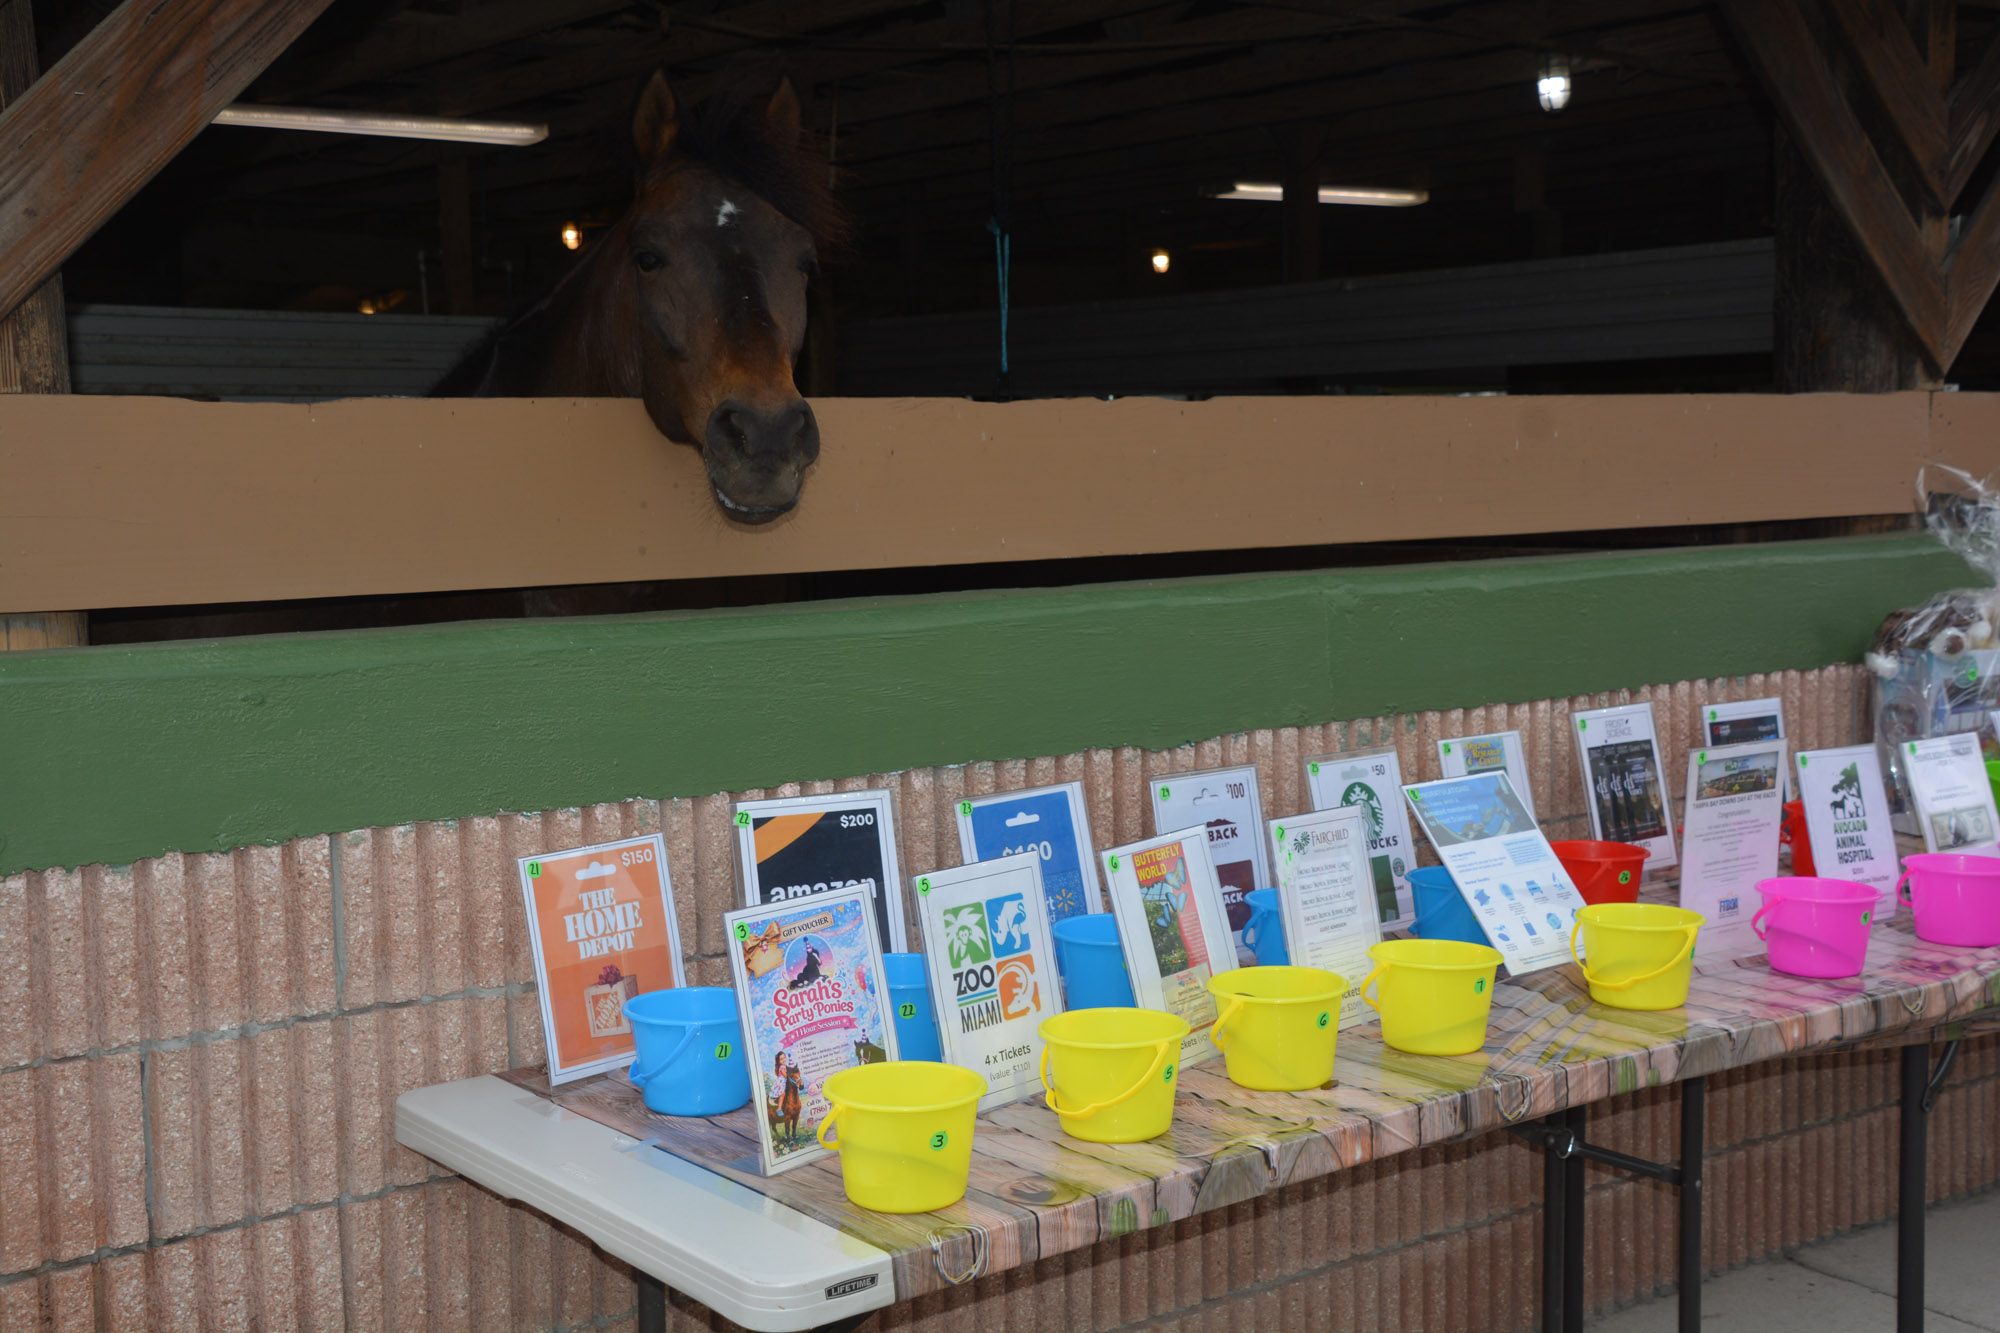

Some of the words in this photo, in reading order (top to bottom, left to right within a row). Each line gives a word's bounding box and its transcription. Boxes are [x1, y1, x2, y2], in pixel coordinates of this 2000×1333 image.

[1372, 765, 1385, 776] $50
[1226, 783, 1245, 799] $100
[962, 803, 972, 814] 23
[738, 812, 750, 825] 22
[840, 813, 874, 828] $200
[1834, 819, 1868, 835] AVOCADO
[1311, 828, 1349, 847] FAIRCHILD
[1836, 834, 1866, 849] ANIMAL
[621, 848, 653, 867] $150
[1111, 856, 1118, 869] 6
[1134, 843, 1180, 867] BUTTERFLY
[1838, 848, 1874, 864] HOSPITAL
[529, 863, 539, 876] 21
[1136, 863, 1167, 881] WORLD
[921, 879, 929, 892] 5
[579, 887, 616, 910] THE
[563, 901, 643, 942] HOME
[782, 925, 798, 938] GIFT
[798, 916, 829, 934] VOUCHER
[736, 925, 747, 938] 3
[578, 931, 635, 960] DEPOT
[953, 965, 995, 997] ZOO
[1476, 980, 1484, 992] 7
[773, 979, 842, 1017] Sarah's
[774, 1006, 815, 1032] Party
[813, 1000, 854, 1017] Ponies
[902, 1004, 915, 1016] 22
[960, 999, 1002, 1034] MIAMI
[1319, 1013, 1327, 1026] 6
[800, 1027, 816, 1036] Hour
[817, 1020, 841, 1031] Session
[718, 1044, 728, 1058] 21
[1180, 1037, 1197, 1050] ckets
[985, 1055, 991, 1066] 4
[992, 1056, 998, 1064] x
[999, 1044, 1031, 1062] Tickets
[1165, 1065, 1173, 1080] 5
[933, 1134, 944, 1148] 3
[831, 1276, 872, 1296] LIFETIME
